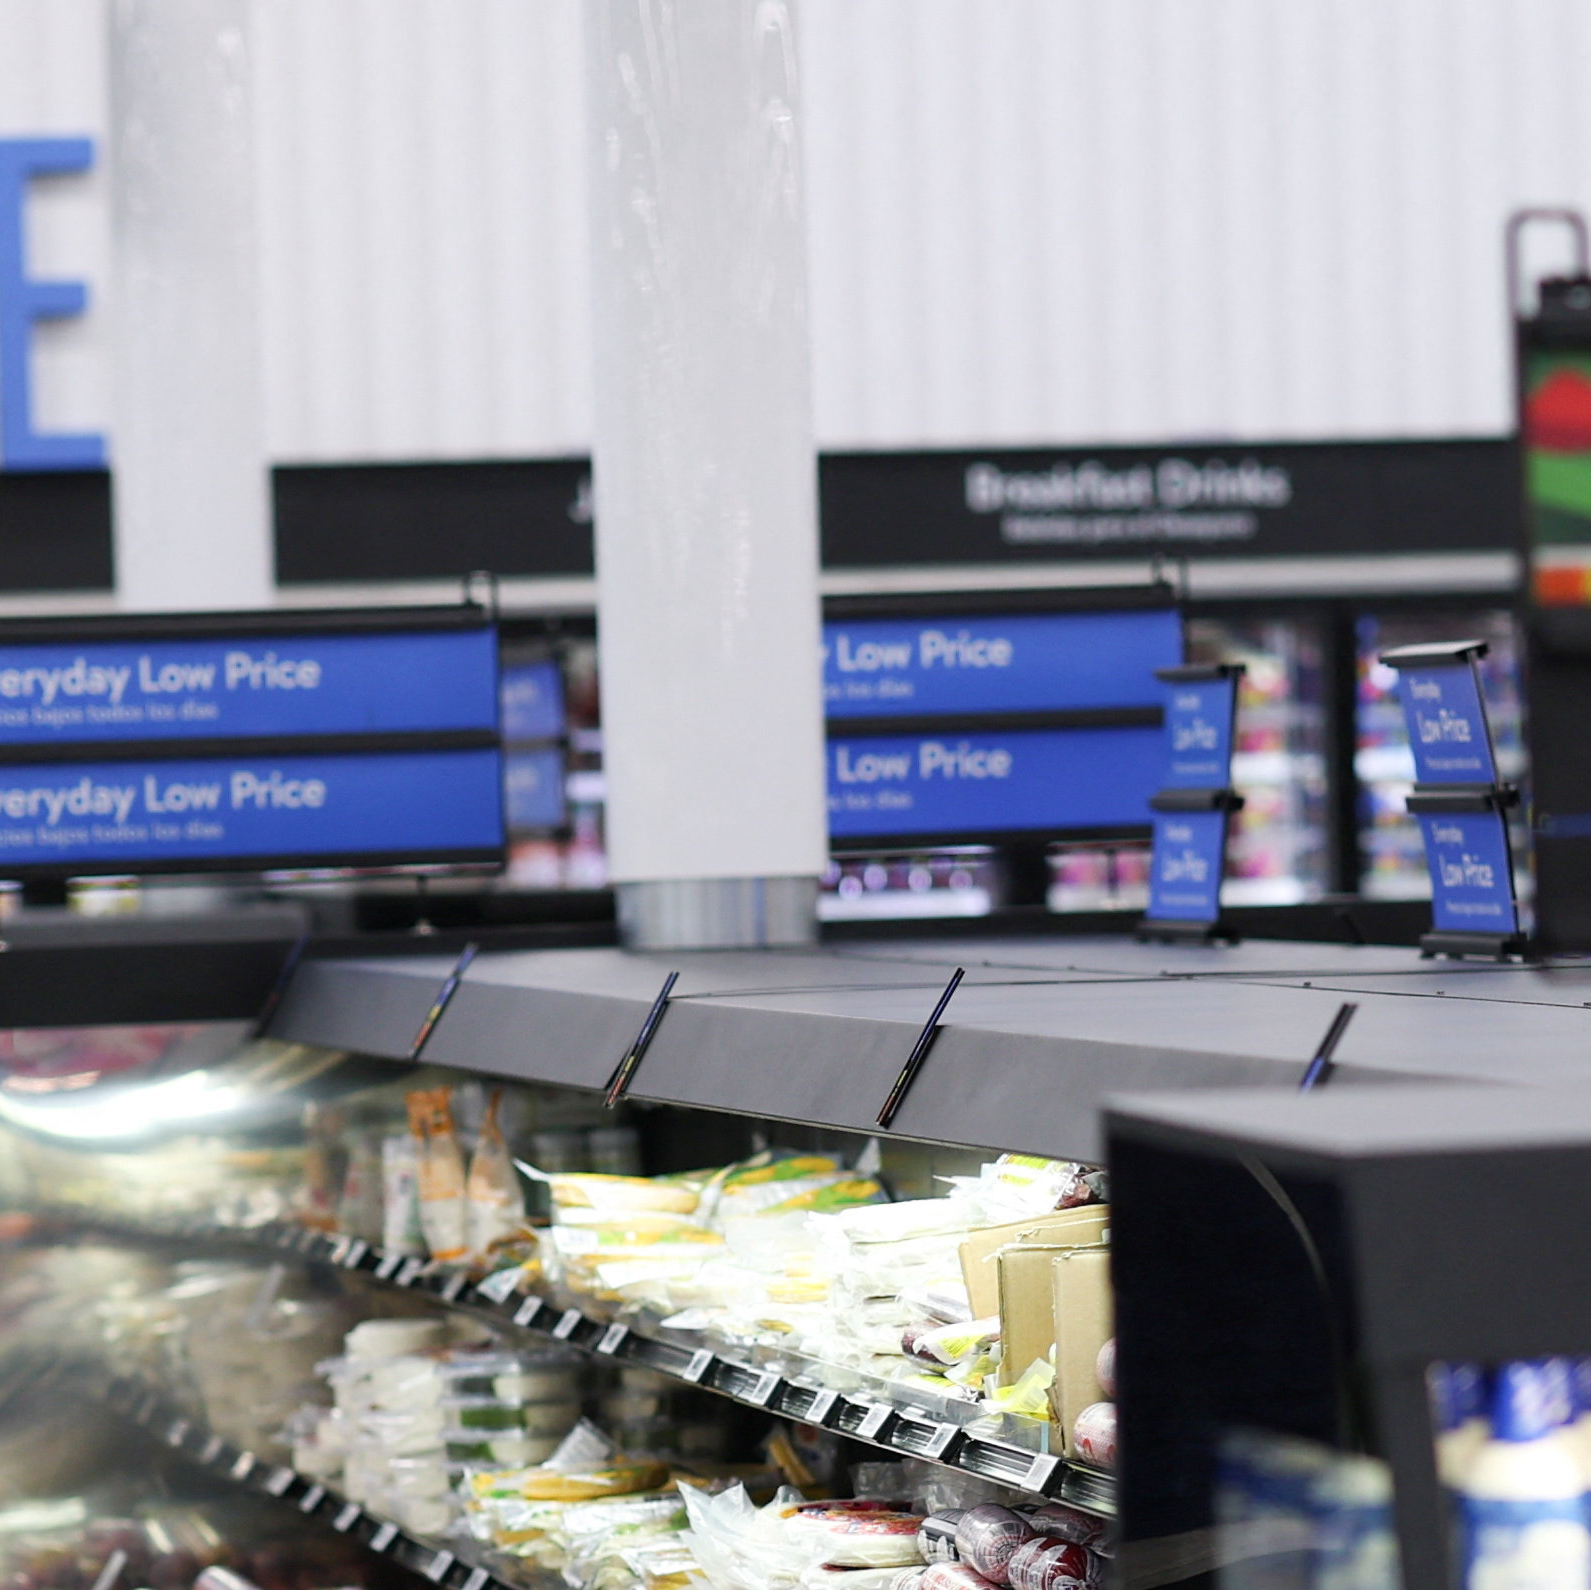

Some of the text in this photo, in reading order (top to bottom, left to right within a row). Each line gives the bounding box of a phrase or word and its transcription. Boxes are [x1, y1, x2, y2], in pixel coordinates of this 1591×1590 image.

[1157, 455, 1292, 509] Drinks
[138, 653, 216, 695] Low
[224, 650, 323, 692] Price
[836, 633, 912, 672] Low
[919, 629, 1013, 670] Price
[836, 740, 1013, 784] Low Price
[143, 774, 221, 815] Low
[230, 770, 328, 811] Price
